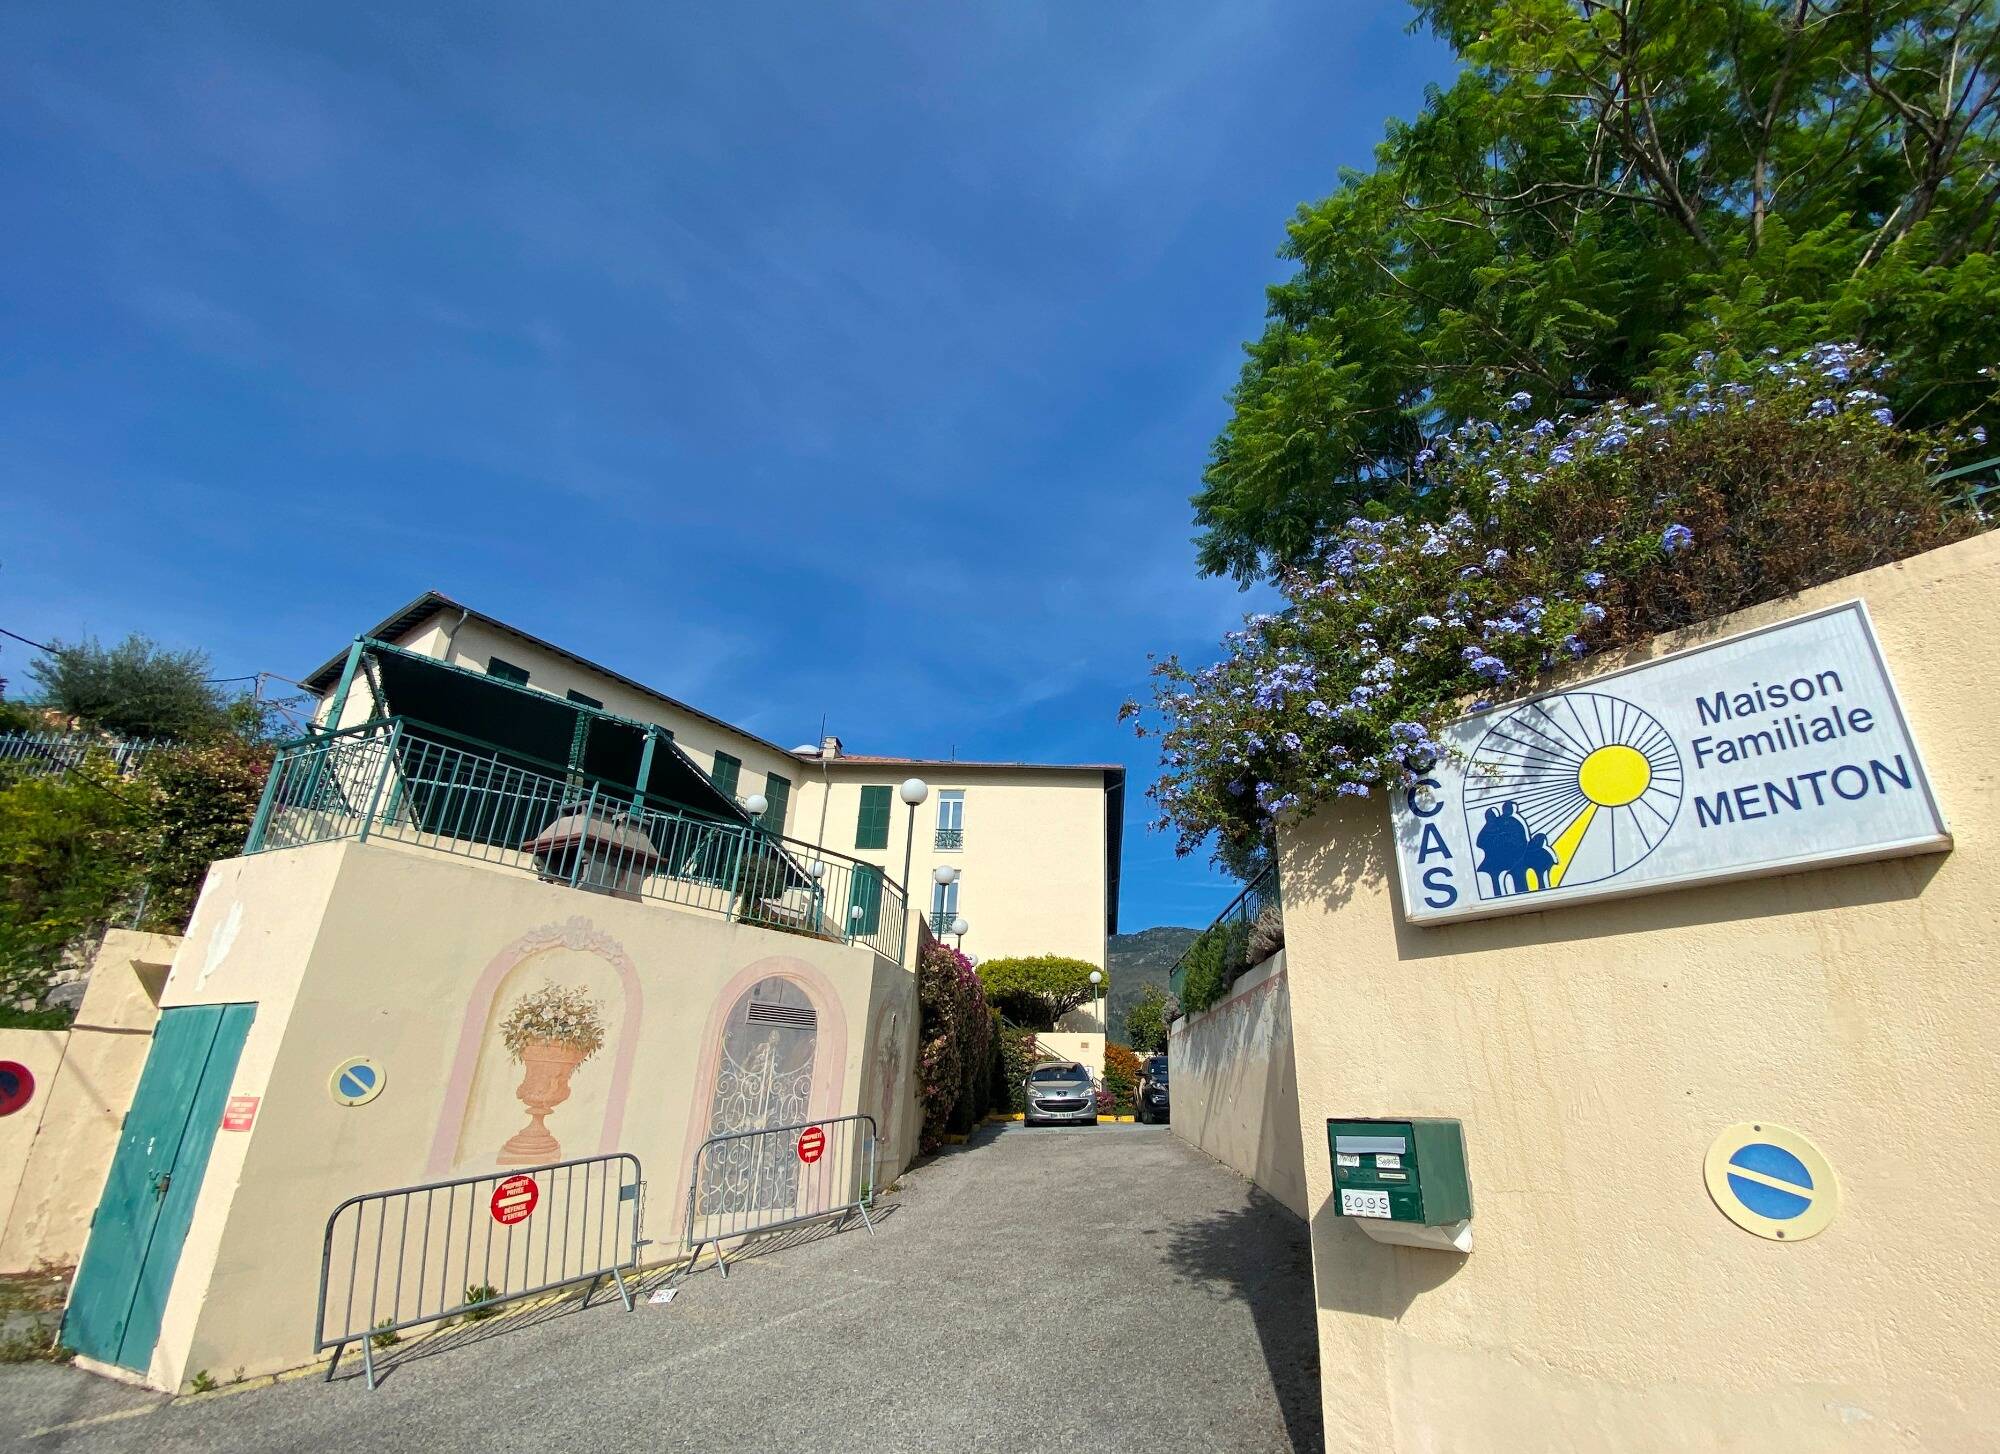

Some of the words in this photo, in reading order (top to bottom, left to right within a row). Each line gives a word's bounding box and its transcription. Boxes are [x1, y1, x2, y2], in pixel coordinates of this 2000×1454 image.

[1696, 670, 1844, 726] Maison
[1692, 705, 1875, 769] Familiale
[1694, 754, 1913, 828] MENTON
[1344, 1195, 1388, 1210] 2095
